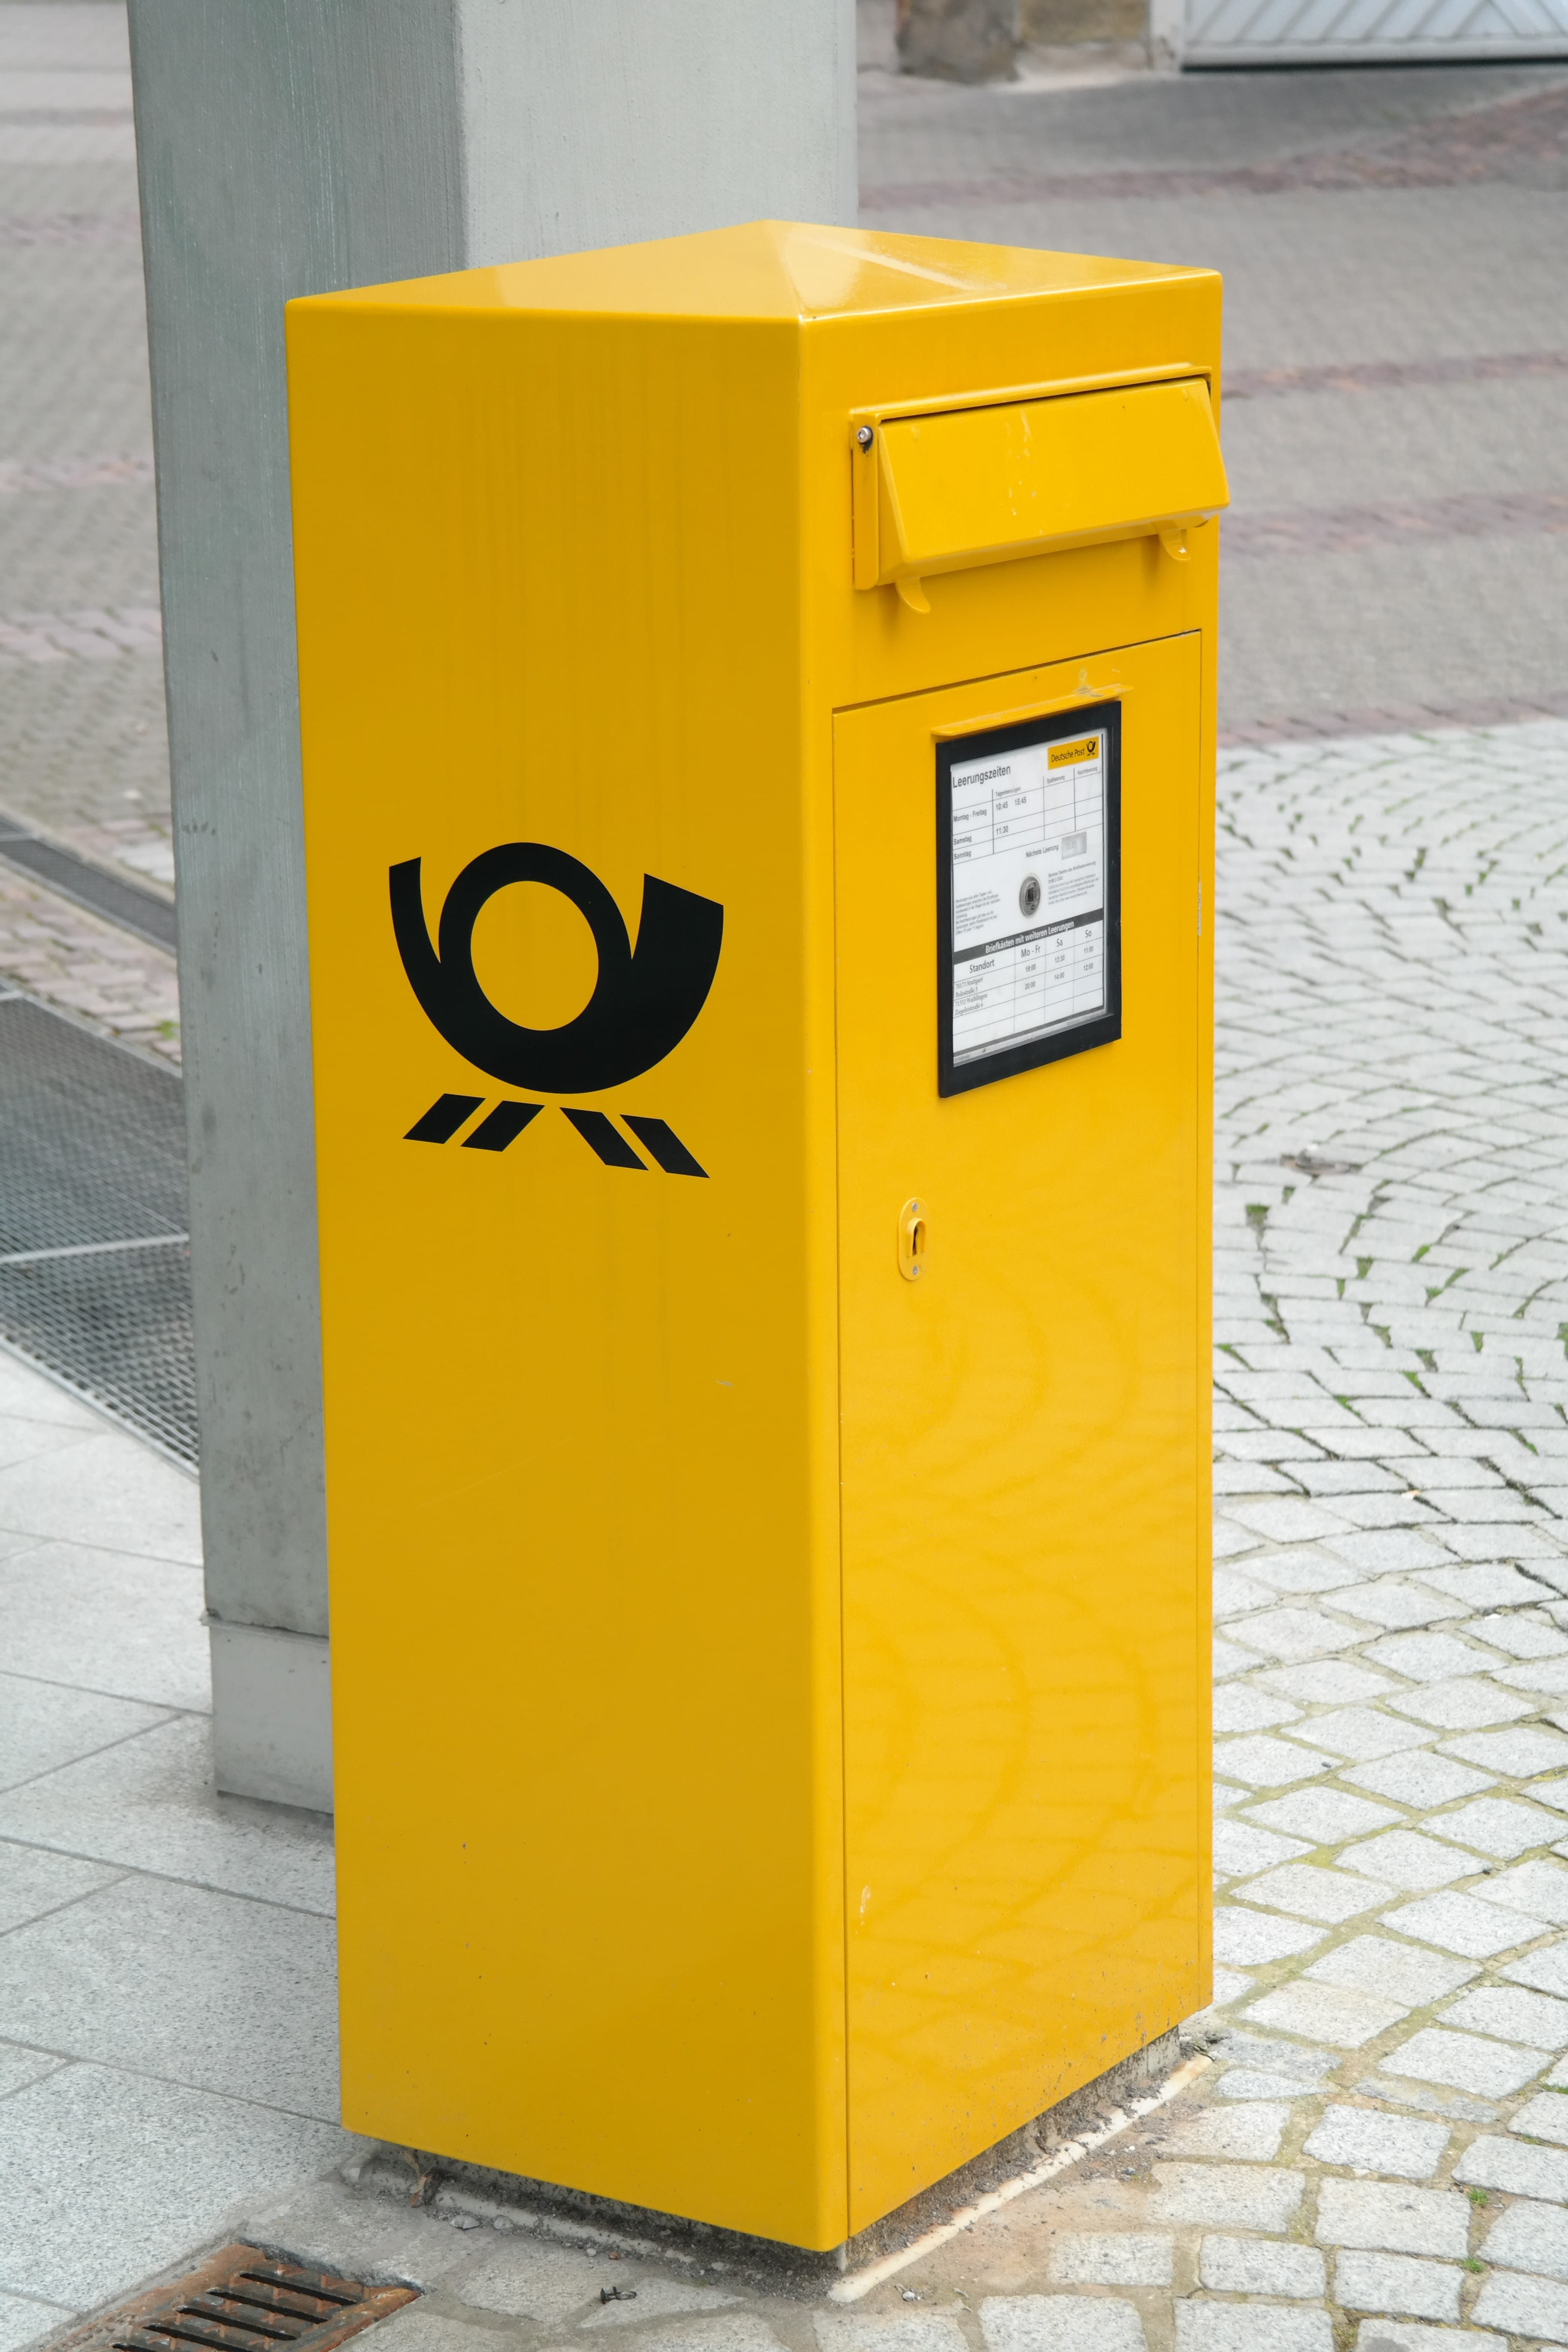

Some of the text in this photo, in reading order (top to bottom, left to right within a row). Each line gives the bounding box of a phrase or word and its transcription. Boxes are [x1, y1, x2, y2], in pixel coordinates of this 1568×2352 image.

[1051, 748, 1085, 763] Deutsche Post
[952, 766, 1011, 788] Leerungszeiten
[996, 796, 1026, 811] 10:45 15:45
[953, 814, 969, 822] Montag
[973, 809, 987, 818] Freitag
[996, 826, 1008, 835] 11:30
[954, 836, 972, 845] Samstag
[954, 851, 971, 860] Sonntag
[1026, 848, 1041, 858] Nächste
[1043, 845, 1059, 853] Leerung
[985, 921, 1074, 953] Briefkästen mit weiteren Leerungen
[1085, 929, 1092, 938] So
[1057, 938, 1063, 947] Sa
[1021, 948, 1030, 958] Mo
[1035, 945, 1041, 954] Fr
[1084, 946, 1093, 954] 11:00
[970, 959, 995, 973] Standort
[967, 977, 983, 986] Stuttgart
